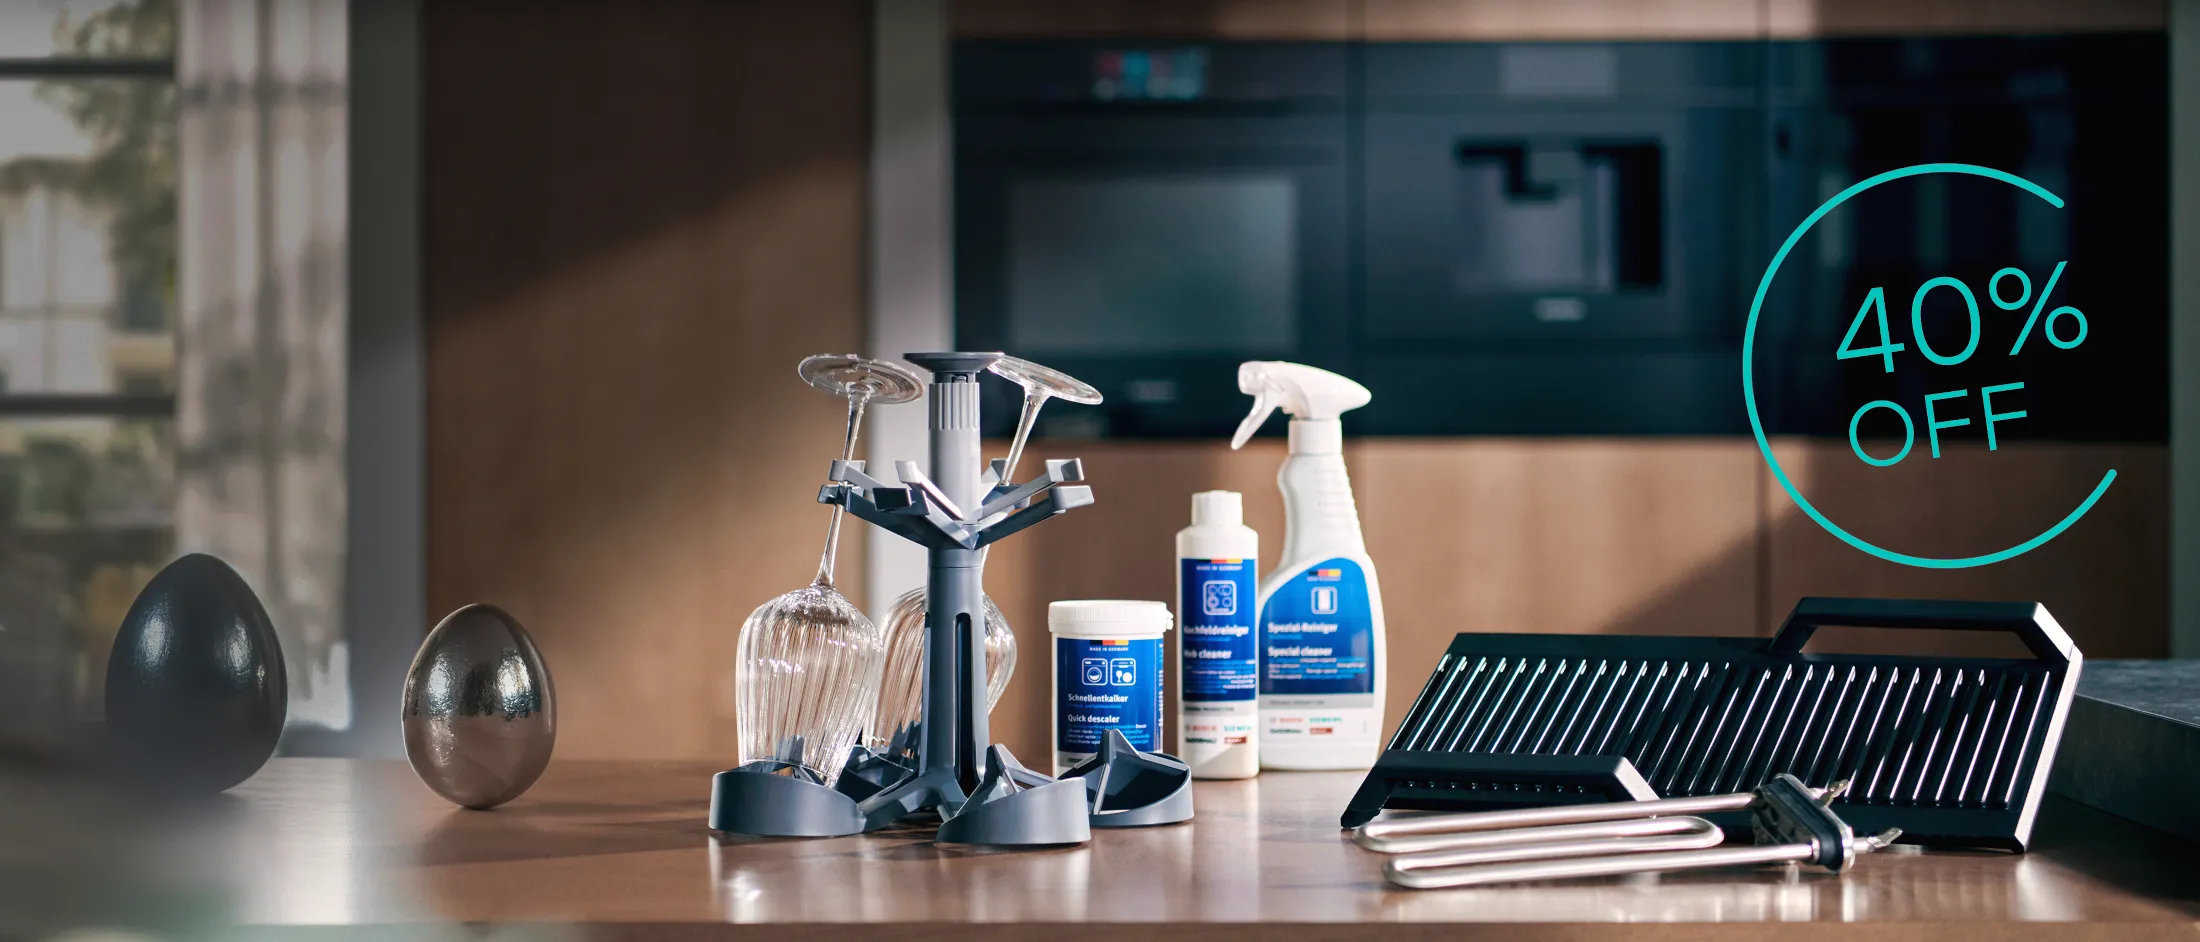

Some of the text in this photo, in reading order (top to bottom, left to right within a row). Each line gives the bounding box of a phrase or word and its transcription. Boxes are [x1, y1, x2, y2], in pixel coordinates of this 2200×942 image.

[1268, 622, 1338, 634] Spezial-Reiniger
[1199, 649, 1232, 659] cleaner
[1268, 645, 1333, 658] Special cleaner
[1068, 693, 1129, 703] Schnellentkalker
[1068, 714, 1120, 723] Quick descaler
